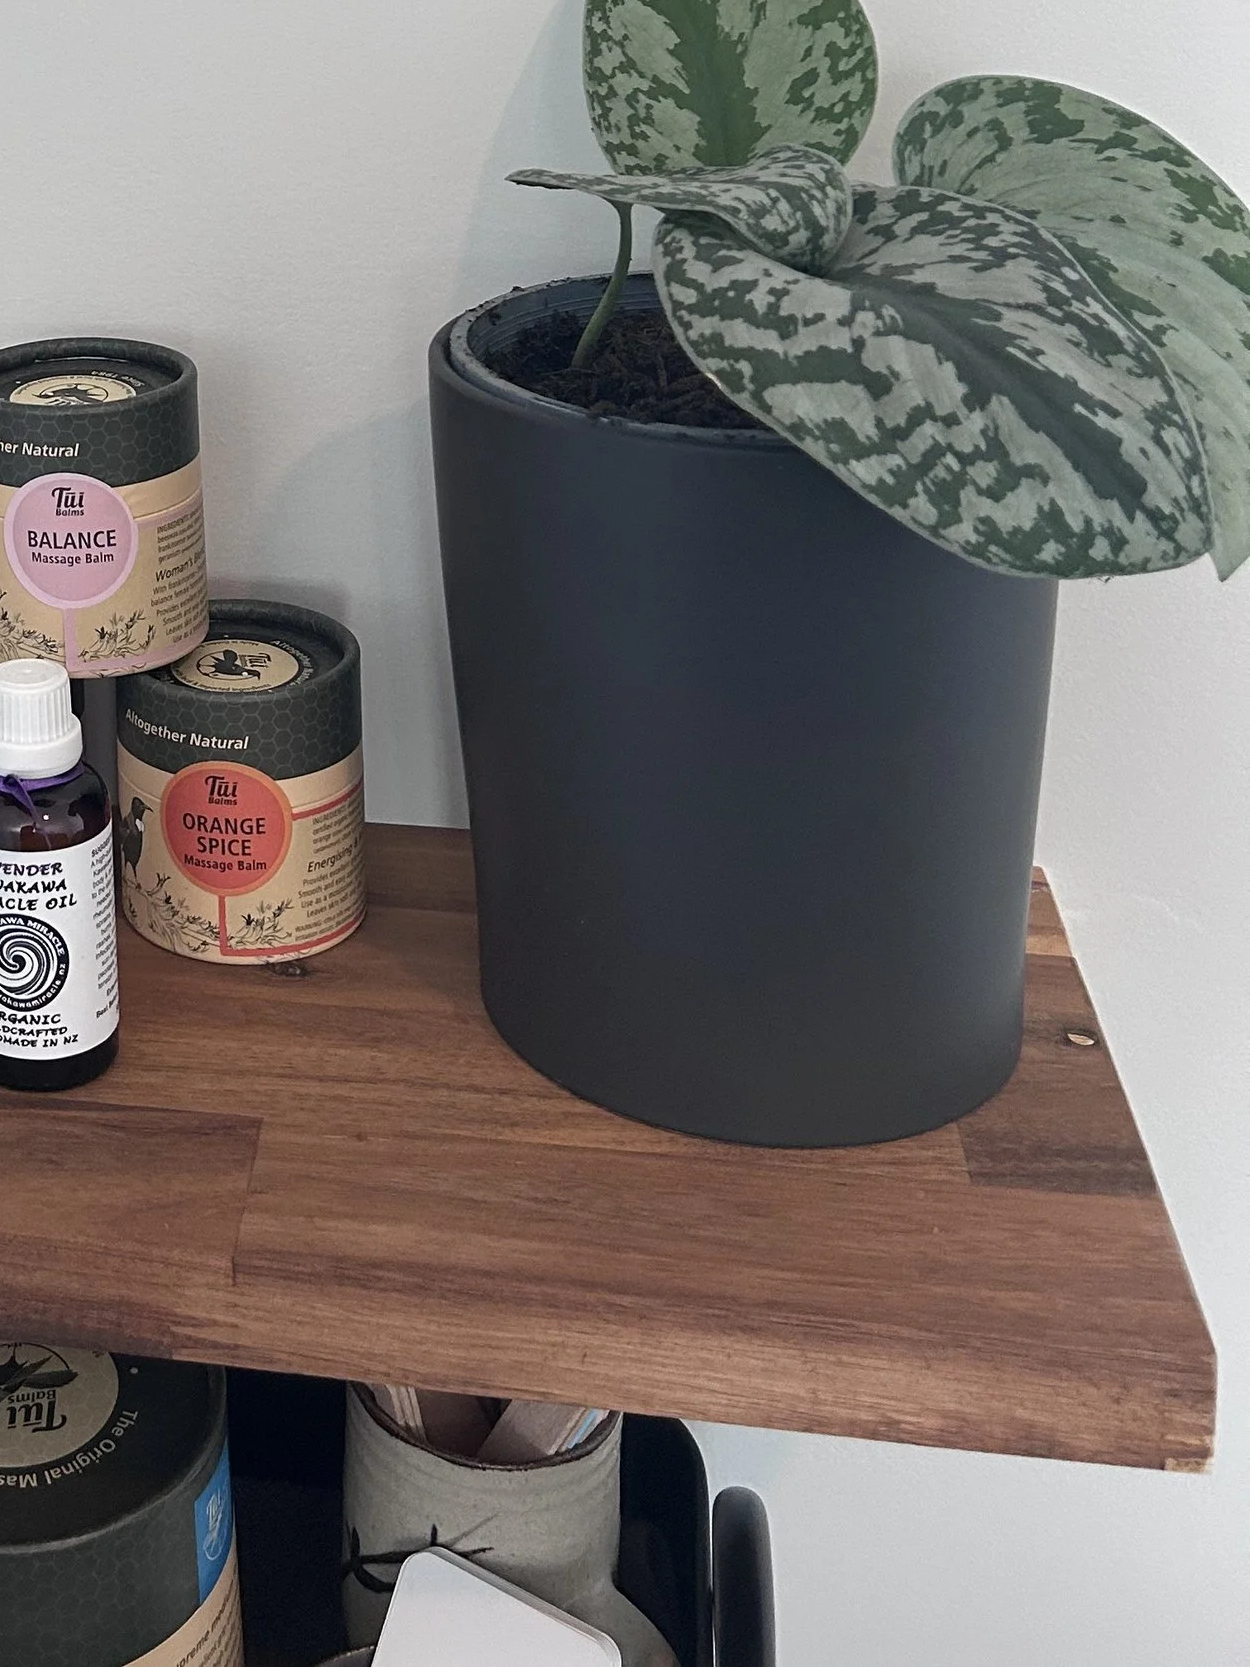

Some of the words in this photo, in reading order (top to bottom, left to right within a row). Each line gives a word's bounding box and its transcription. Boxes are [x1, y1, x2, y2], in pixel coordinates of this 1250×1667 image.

[21, 442, 80, 458] Natural
[55, 508, 85, 517] Balms
[27, 529, 117, 549] BALANCE
[31, 551, 81, 567] Massage
[85, 552, 114, 564] Balm
[155, 556, 193, 581] Woman's
[125, 708, 186, 744] Altogether
[189, 733, 249, 750] Natural
[208, 796, 238, 806] Balms
[182, 812, 266, 835] ORANGE
[197, 836, 252, 856] SPICE
[183, 853, 234, 873] Massage
[237, 860, 267, 871] Balm
[307, 844, 352, 873] Energising
[302, 873, 329, 887] Provides
[45, 893, 78, 910] OIL
[298, 886, 323, 899] Smooth
[301, 898, 313, 909] Use
[306, 905, 328, 918] Leaves
[26, 920, 66, 956] MIRACLE
[42, 1038, 58, 1047] IN
[63, 1034, 79, 1046] NZ
[7, 1389, 56, 1403] Balms
[111, 1410, 138, 1436] The
[45, 1438, 116, 1485] Original
[176, 1630, 210, 1667] preme
